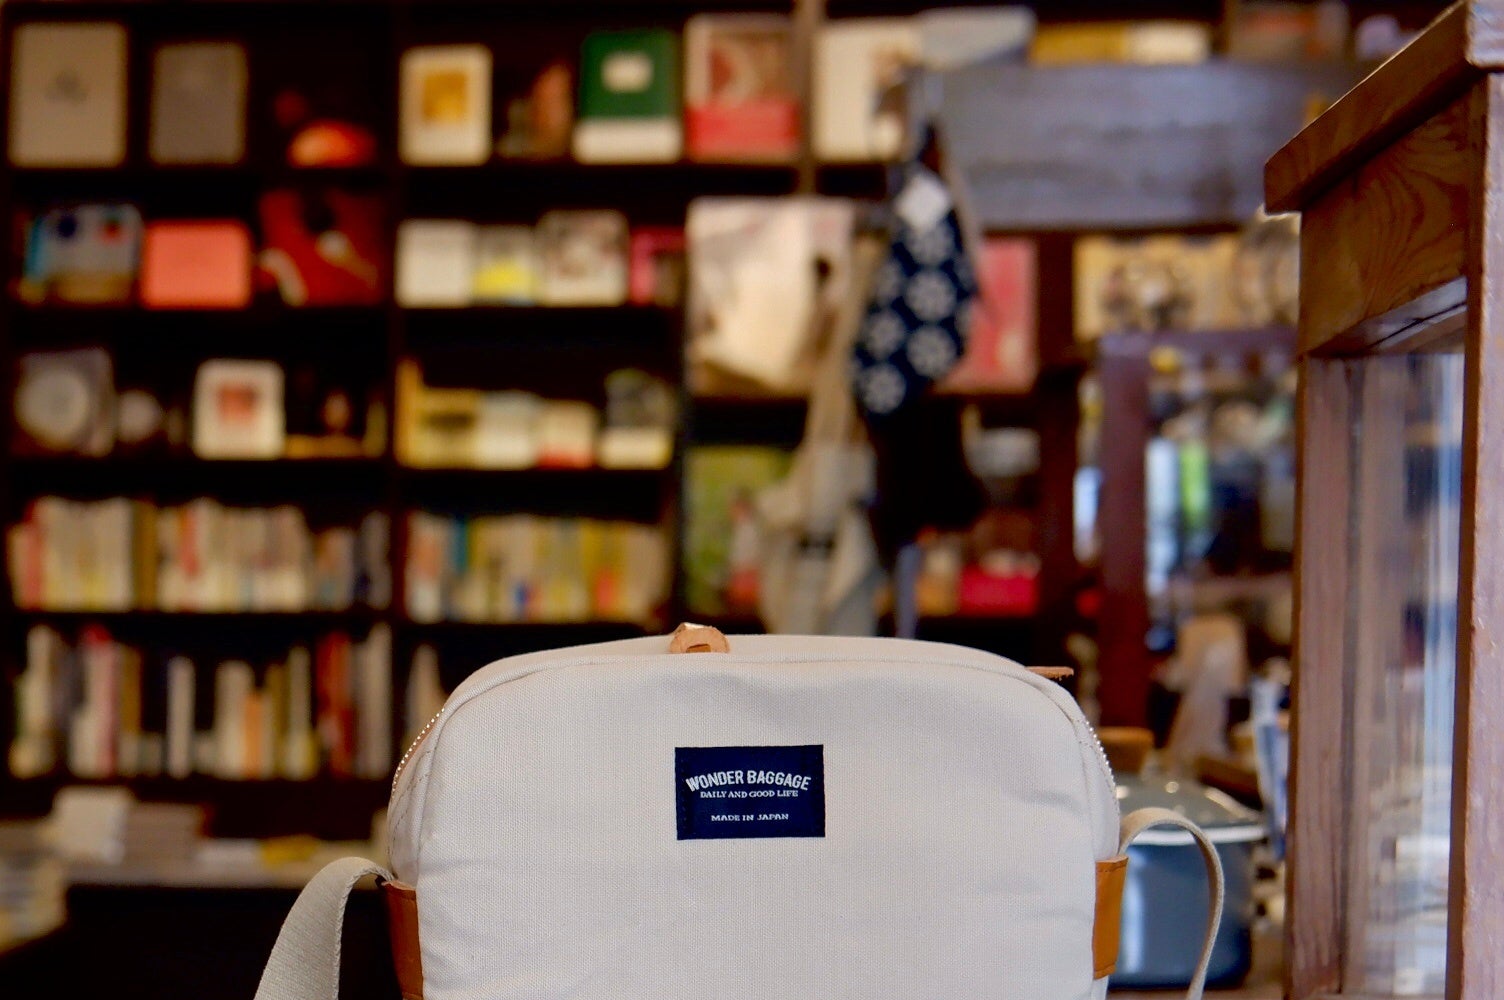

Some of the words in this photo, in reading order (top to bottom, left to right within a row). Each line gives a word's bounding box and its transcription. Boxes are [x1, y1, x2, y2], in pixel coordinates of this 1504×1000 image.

[685, 769, 745, 793] WONDER
[746, 769, 812, 791] BAGGAGE
[700, 790, 727, 799] DAILY
[727, 790, 748, 799] AND
[748, 789, 776, 799] GOOD
[776, 789, 799, 798] LIFE
[710, 814, 741, 822] MADE
[742, 814, 755, 822] IN
[756, 813, 789, 822] JAPAN
